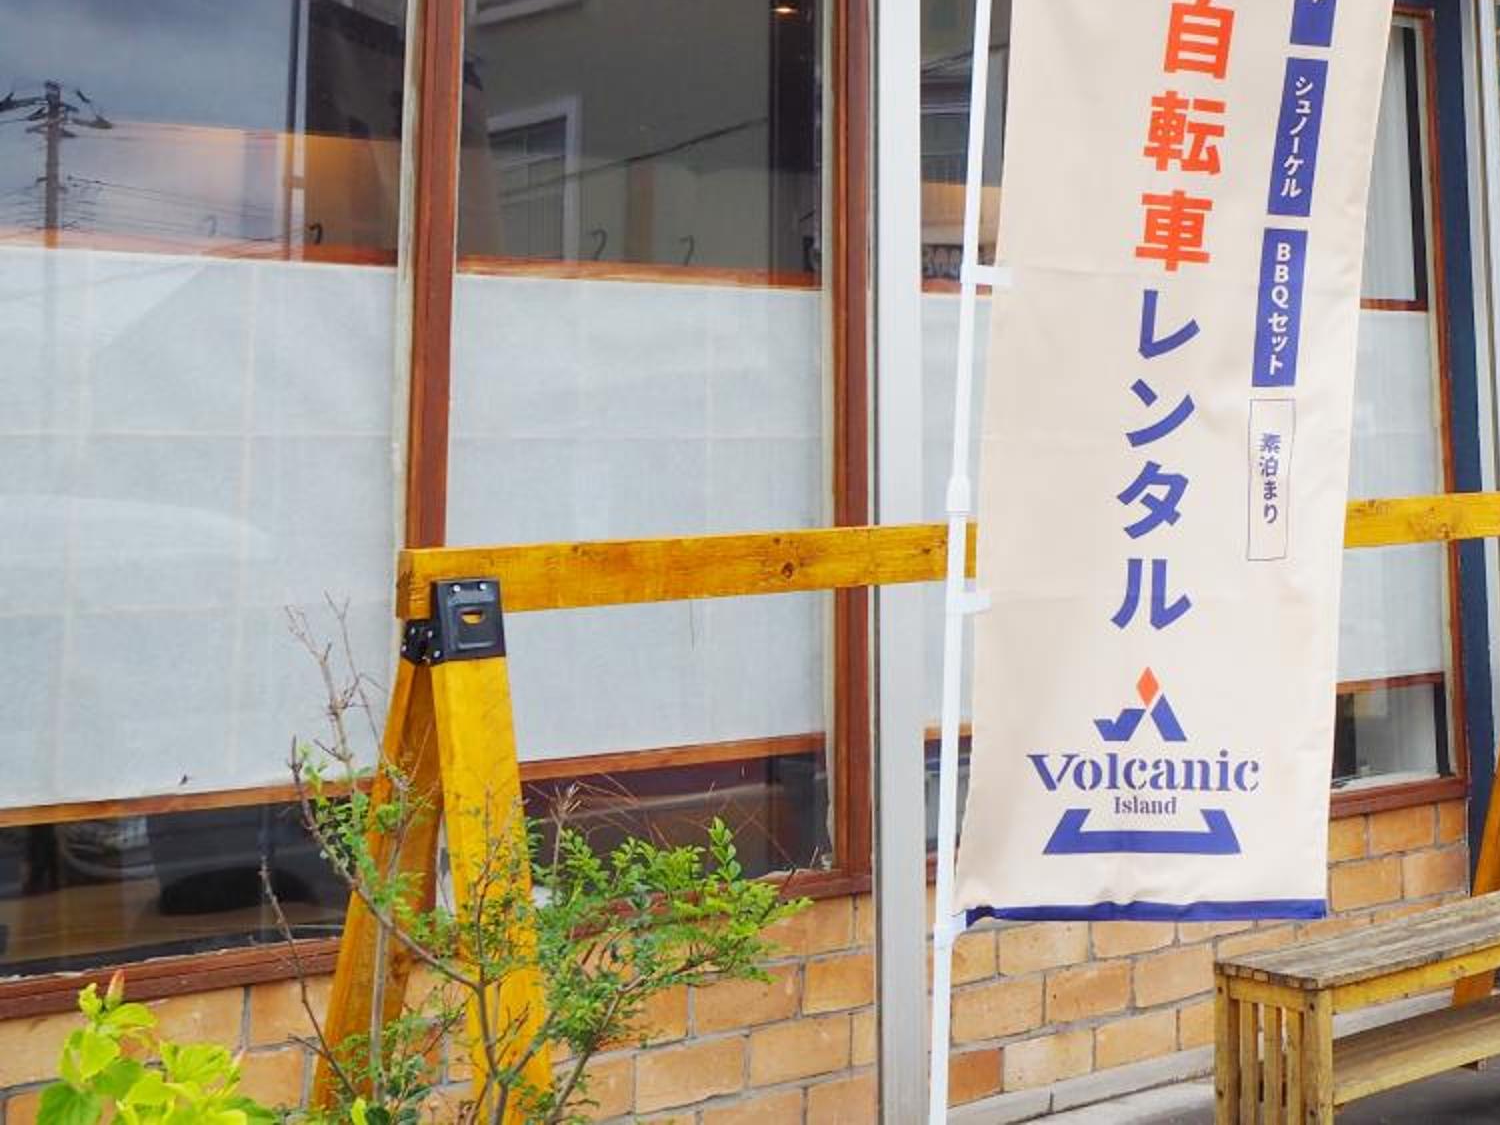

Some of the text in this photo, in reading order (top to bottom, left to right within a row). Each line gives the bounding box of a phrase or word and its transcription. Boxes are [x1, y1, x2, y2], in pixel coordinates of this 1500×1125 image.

[1280, 75, 1313, 199] シュノーケル
[1267, 242, 1292, 376] BBQセット
[1259, 431, 1281, 525] 素泊まり
[1026, 749, 1260, 792] Volcanic
[1113, 795, 1177, 815] Island
